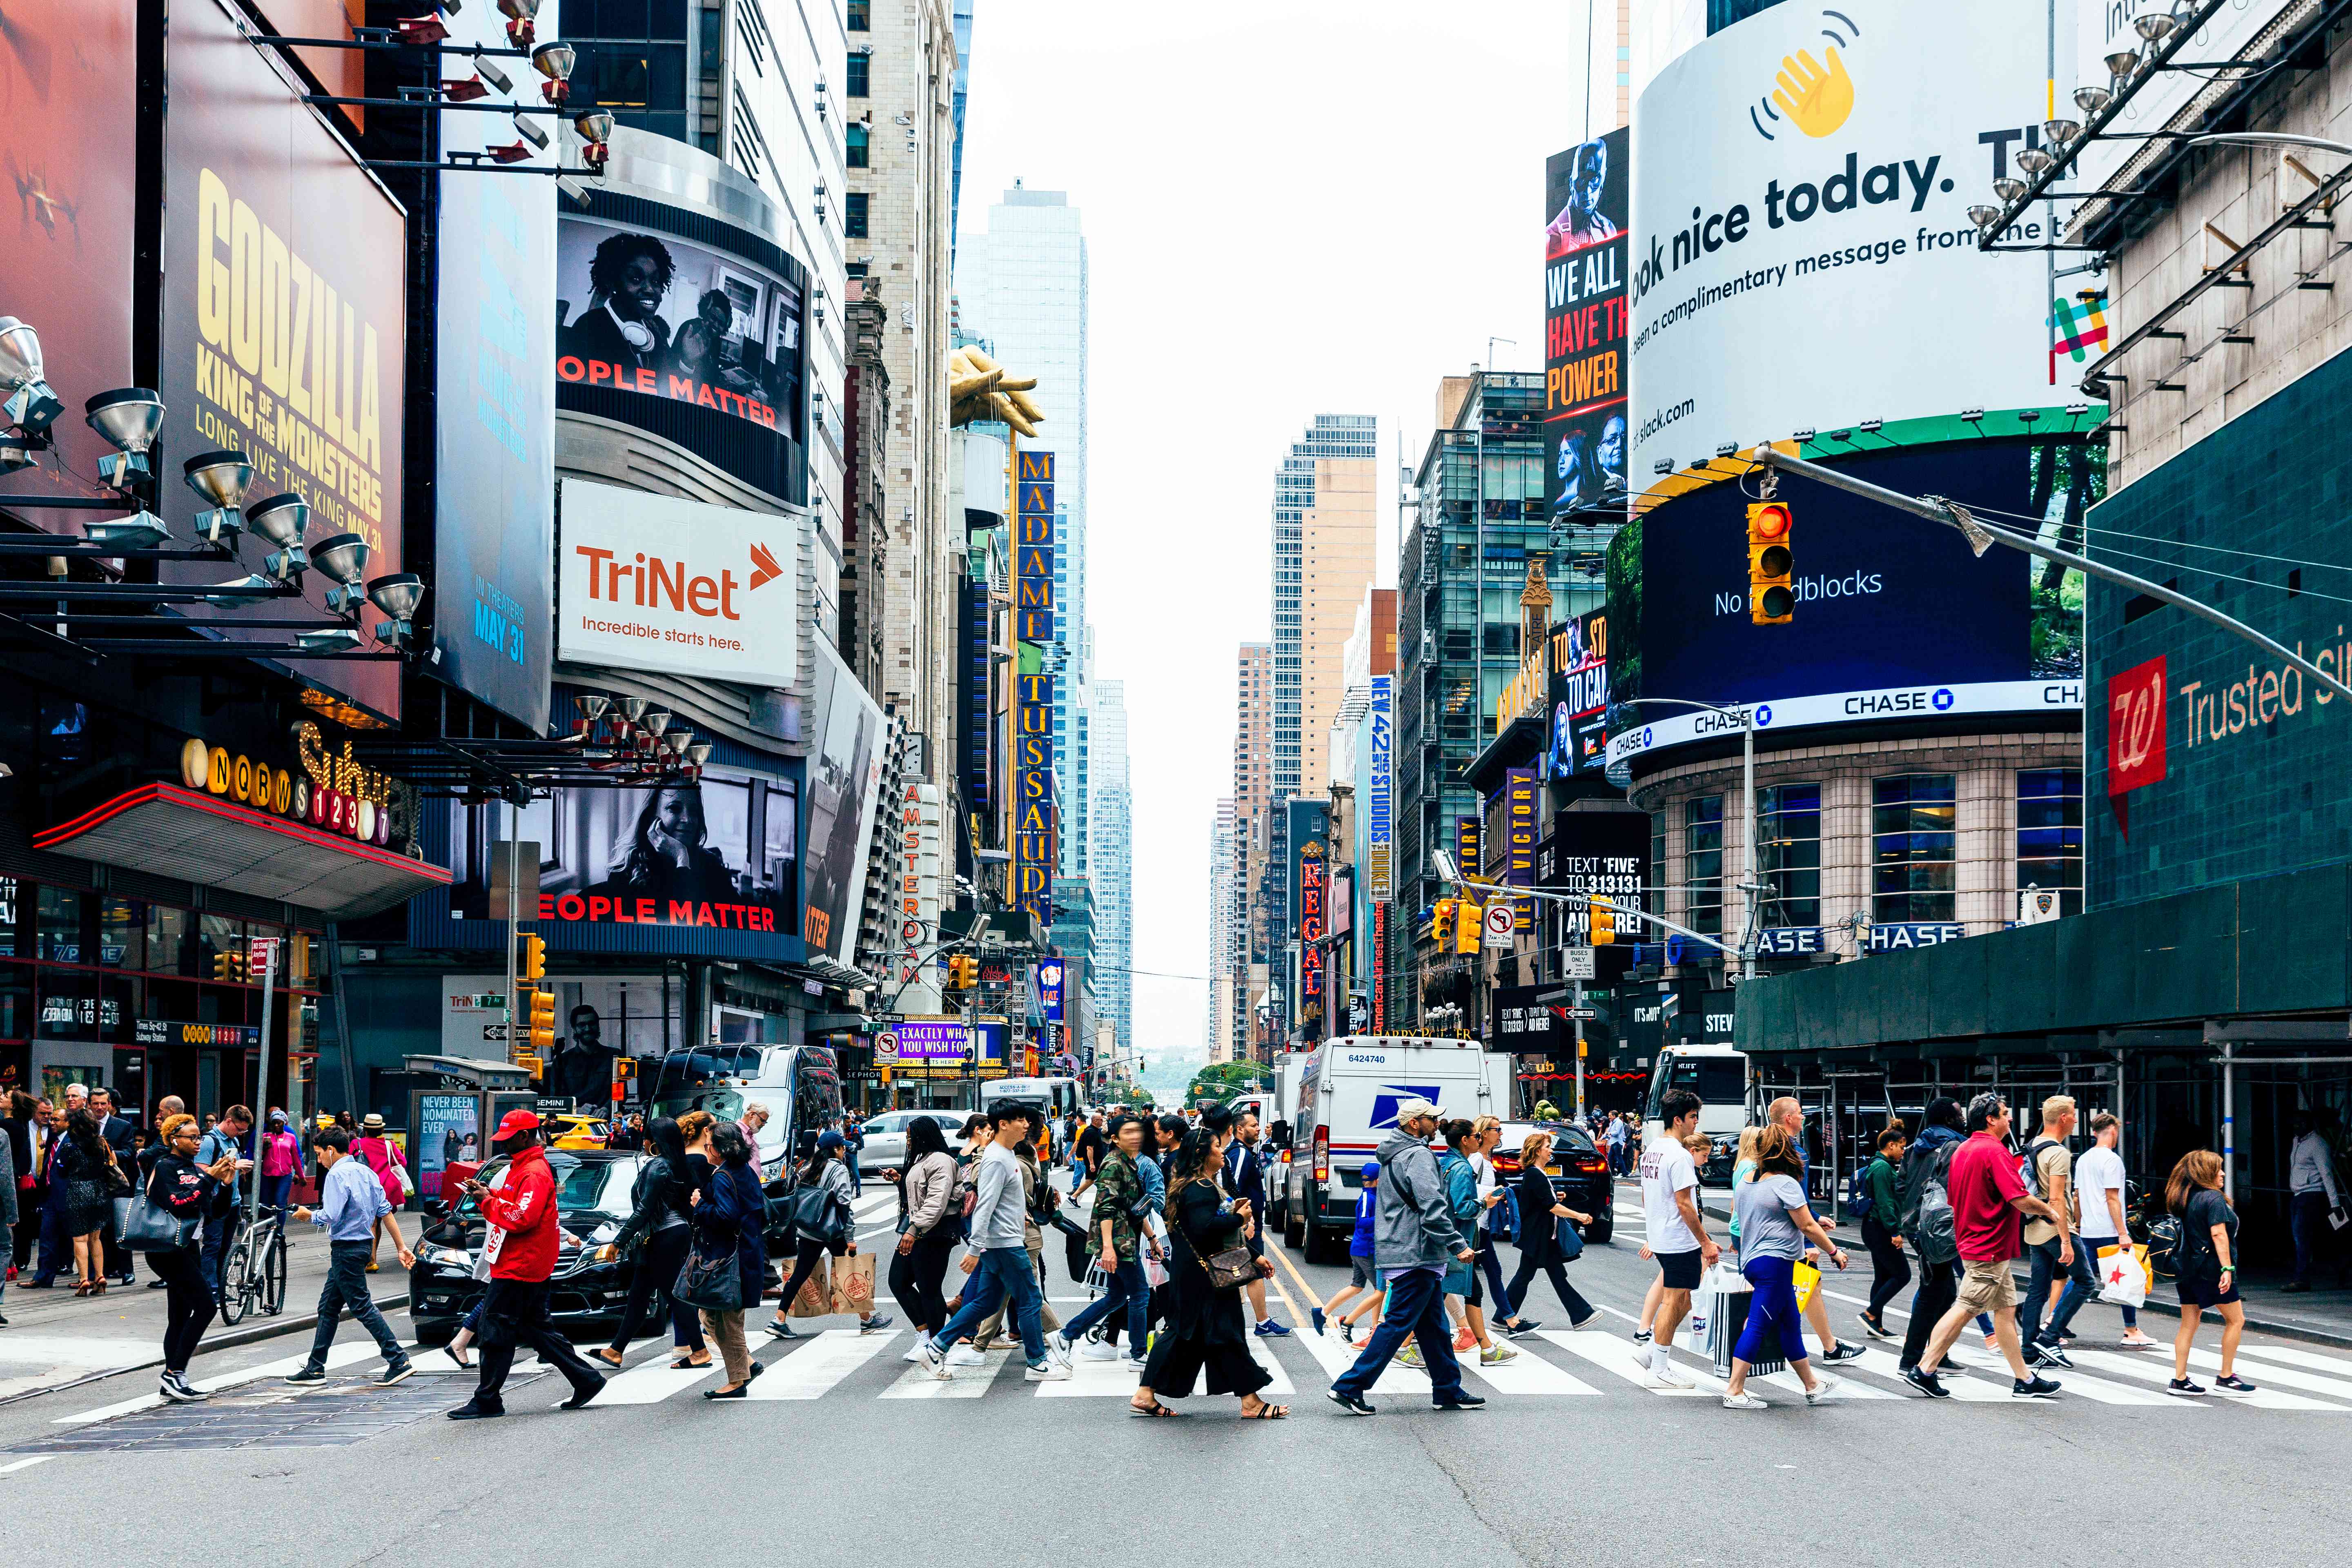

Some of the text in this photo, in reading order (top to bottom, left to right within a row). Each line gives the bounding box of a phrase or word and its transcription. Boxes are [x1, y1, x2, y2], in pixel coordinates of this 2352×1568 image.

[1673, 204, 1750, 272] nice
[1764, 152, 1954, 229] today.
[1547, 247, 1620, 309] WE ALL
[1634, 327, 1650, 356] been
[1652, 320, 1659, 336] a
[1661, 263, 1787, 330] complimentary
[1795, 238, 1906, 276] message
[1917, 227, 1980, 252] from
[198, 168, 381, 475] GODZILLA
[1548, 302, 1602, 360] HAVE
[1548, 351, 1617, 411] POWER
[669, 375, 776, 430] MATTER
[196, 341, 382, 523] KING OF THE MONSTERS
[1640, 398, 1695, 444] slack.com
[196, 404, 239, 451] LONG
[283, 466, 307, 504] THE
[314, 487, 344, 527] KING
[347, 510, 368, 544] MAY
[372, 528, 381, 554] 31
[1022, 453, 1052, 639] MADAME
[475, 574, 525, 625] IN THEATERS
[576, 545, 740, 621] TriNet
[1715, 592, 1742, 616] No
[474, 598, 525, 666] MAY 31
[582, 616, 744, 652] Incredible starts here.
[1552, 631, 1568, 673] TO
[1371, 677, 1390, 713] NEW
[1567, 673, 1582, 715] TO
[1844, 692, 1926, 715] CHASE
[2180, 641, 2302, 748] Trusted
[1616, 732, 1642, 756] CHASE
[217, 754, 387, 838] N Q R W S 1 2 3 7
[1371, 775, 1390, 842] STUDIOS
[1512, 775, 1531, 869] VICTORY
[1372, 850, 1390, 889] DUKE
[1567, 857, 1599, 873] TEXT
[901, 784, 921, 984] AMSTERDAM
[1567, 875, 1641, 893] TO 313131
[539, 894, 775, 933] EOPLE MATTER
[1302, 863, 1322, 995] REGAL
[487, 997, 491, 1006] 7
[1349, 998, 1358, 1030] DANCE
[1502, 1009, 1511, 1019] TEXT
[1635, 1007, 1646, 1022] IT'S
[136, 1021, 148, 1030] Times
[136, 1032, 166, 1043] Subway Station
[1502, 1020, 1523, 1033] TO 313131
[1528, 1017, 1549, 1031] AD HERE!
[1706, 1014, 1734, 1032] STEV
[902, 1041, 948, 1053] YOU WISH
[1348, 1054, 1385, 1063] 6424740
[433, 1062, 459, 1074] Phone
[423, 1096, 473, 1108] NEVER BEEN
[423, 1109, 476, 1121] NOMINATED.
[423, 1122, 446, 1134] EVER.
[518, 1191, 534, 1211] TOP
[848, 1283, 866, 1293] TRADER
[852, 1288, 866, 1297] JOE'S
